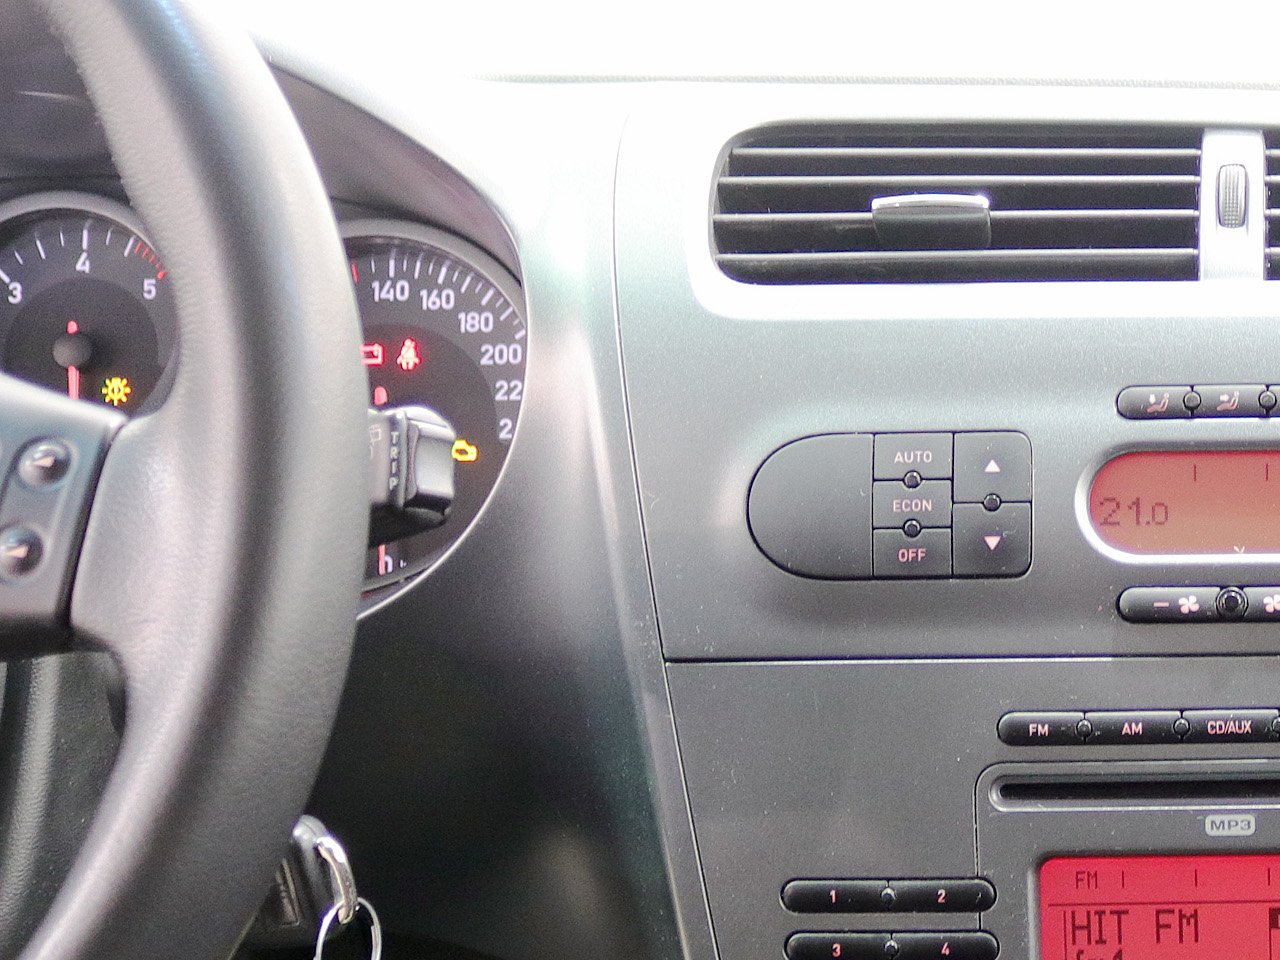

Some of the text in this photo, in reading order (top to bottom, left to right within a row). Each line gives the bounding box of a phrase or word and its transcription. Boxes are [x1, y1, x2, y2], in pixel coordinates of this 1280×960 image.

[75, 253, 91, 273] 4
[8, 284, 22, 303] 3
[142, 279, 157, 299] 5
[371, 281, 410, 302] 140
[419, 290, 456, 311] 160
[457, 312, 494, 333] 180
[480, 345, 522, 364] 200
[494, 381, 522, 401] 22
[388, 431, 400, 491] TRIP
[893, 450, 933, 464] AUTO
[892, 500, 932, 513] ECON
[1099, 498, 1169, 526] 21.0
[897, 548, 927, 562] OFF
[1028, 723, 1049, 736] FM
[1121, 722, 1143, 735] AM
[1206, 720, 1252, 734] CD/AUX
[1209, 818, 1253, 833] MP3
[1075, 871, 1098, 888] FM
[829, 890, 838, 903] 1
[937, 889, 946, 903] 2
[1070, 909, 1200, 945] HIT FM
[832, 943, 842, 957] 3
[941, 943, 951, 956] 4
